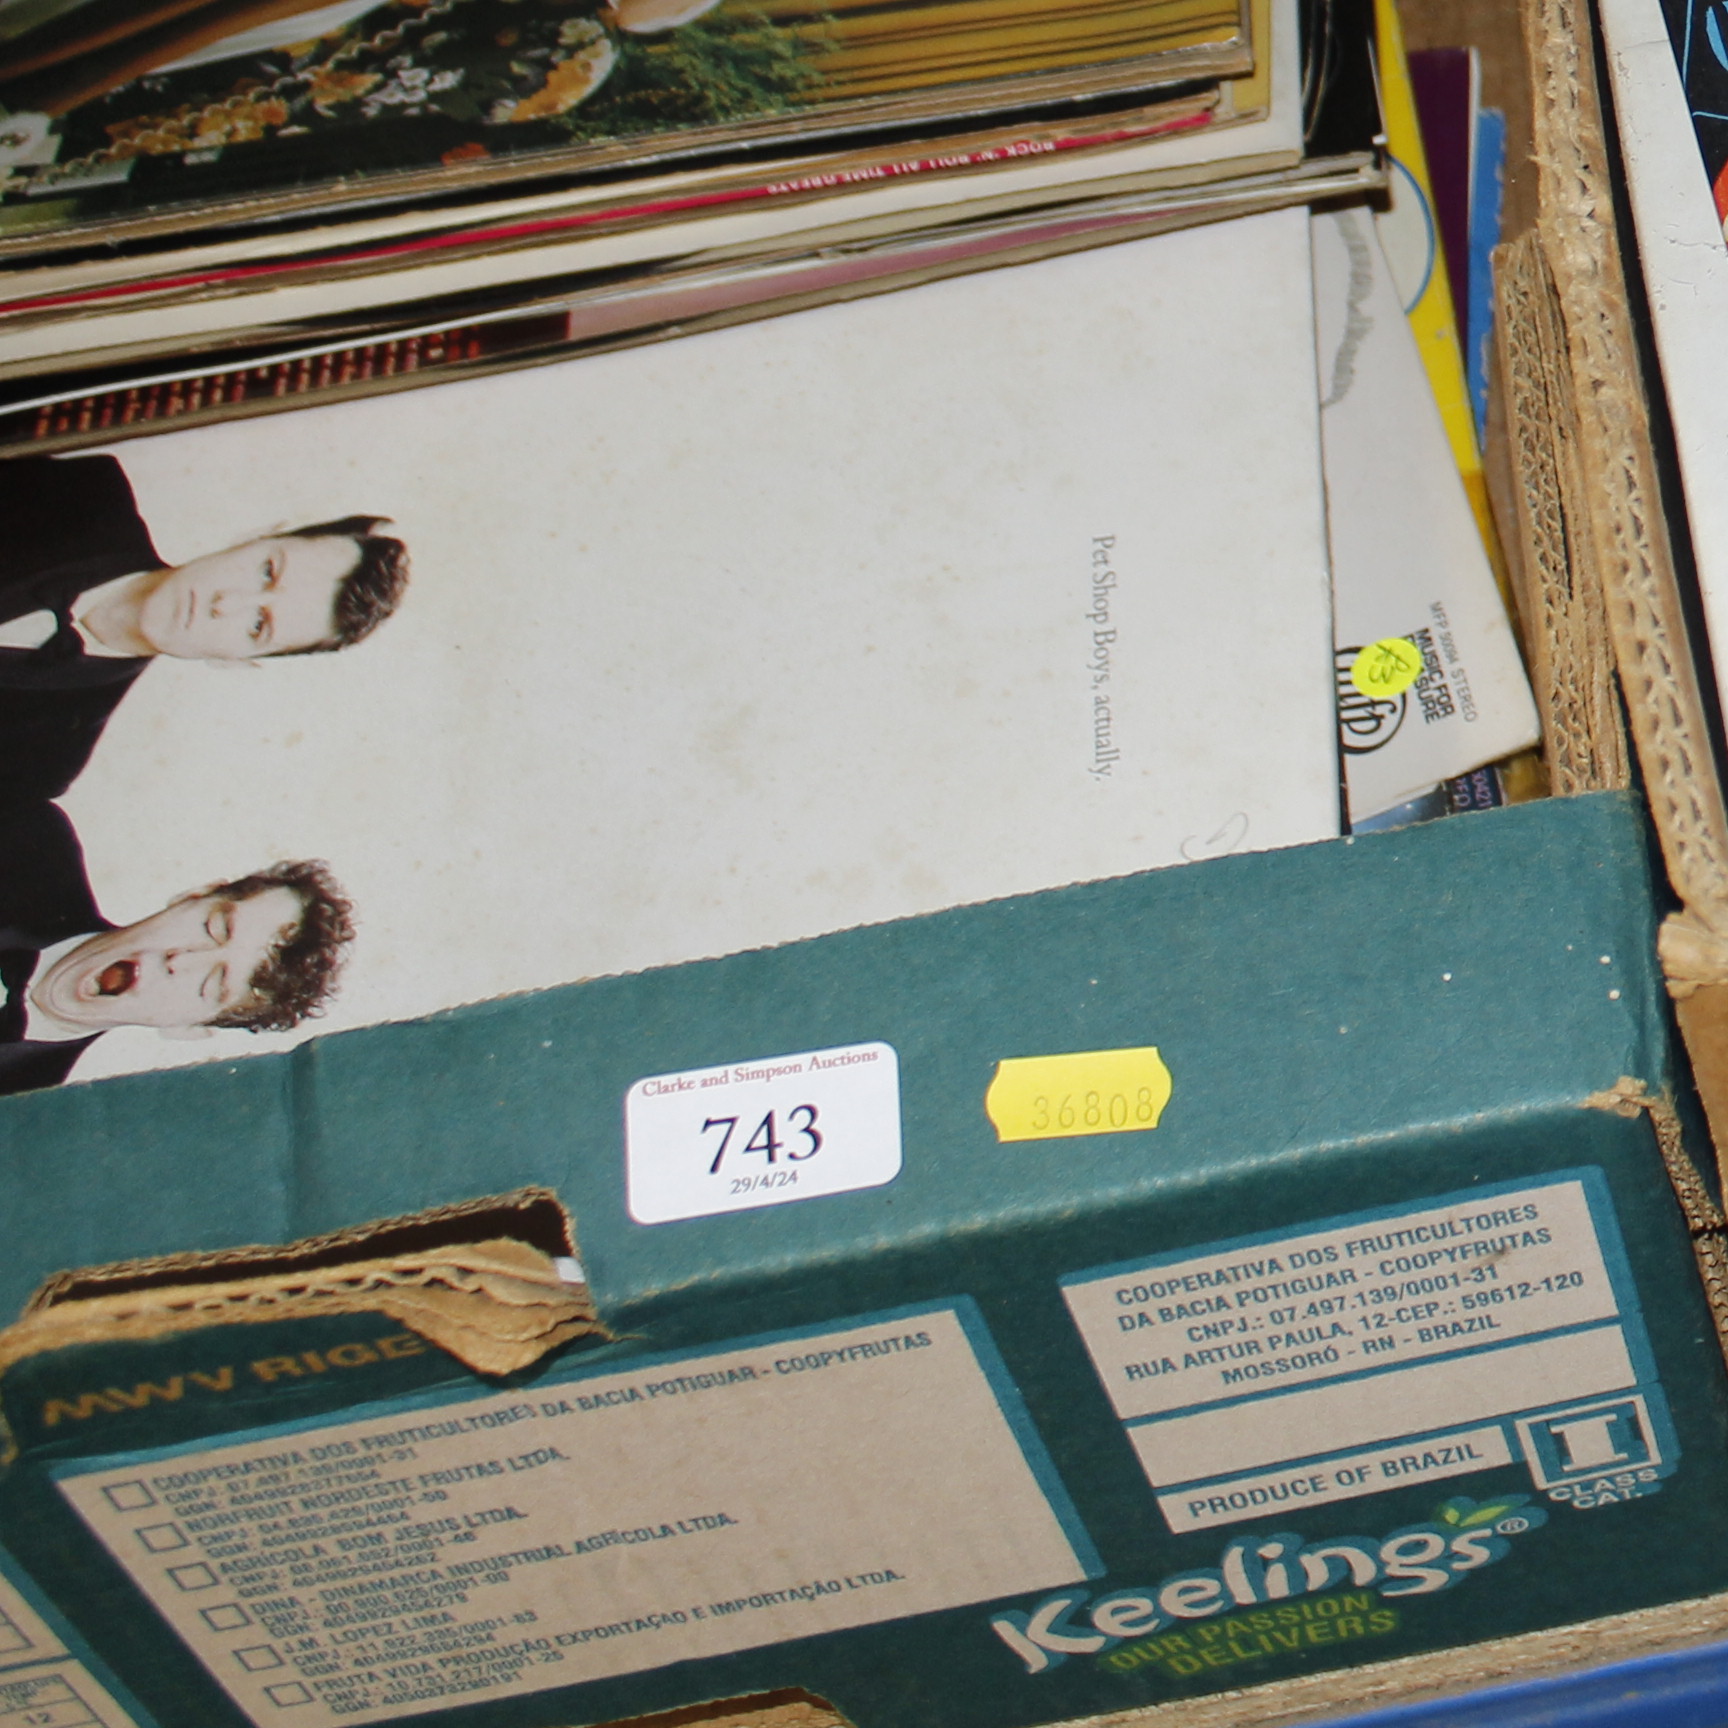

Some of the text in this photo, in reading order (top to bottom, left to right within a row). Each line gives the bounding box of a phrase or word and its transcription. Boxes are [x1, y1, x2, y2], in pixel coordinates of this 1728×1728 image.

[841, 165, 886, 183] TIME
[891, 159, 920, 174] ALL
[928, 153, 970, 169] ROLL
[1003, 138, 1056, 158] ROCK
[1081, 533, 1122, 782] Pet Shop Boys, actually.
[1415, 628, 1455, 717] MUSIC FOR
[1429, 599, 1449, 629] MFP
[1451, 667, 1478, 722] STEREO
[641, 1048, 879, 1098] Clarke and Simpson Auctions
[1031, 1084, 1156, 1133] 36808
[700, 1103, 824, 1175] 743
[729, 1169, 800, 1196] 29/4/24
[1113, 1202, 1542, 1307] COOPERATIVA DOS FRUTICULTORES
[1116, 1225, 1554, 1333] DA BACIA POTIGUAR COOPYFRUTAS
[1124, 1269, 1587, 1382] RUA ARTUR PAULA, 12-CEP.: 59612-120
[1266, 1262, 1502, 1327] 07.497.139/0001-31
[43, 1332, 427, 1427] MWV RIGE
[1217, 1312, 1502, 1385] MOSSORÓ RN BRAZIL
[147, 1449, 310, 1492] COOPERATIVA
[307, 1439, 361, 1461] DOS
[353, 1404, 542, 1451] FRUTICULTORES
[537, 1398, 576, 1418] DA
[572, 1386, 644, 1411] BACIA
[642, 1364, 761, 1398] POTIGUAR
[768, 1330, 937, 1375] COOPYFRUTAS
[1549, 1412, 1635, 1473] I
[181, 1501, 300, 1533] NORFRUIT
[295, 1477, 421, 1511] NORDESTE
[415, 1460, 507, 1488] FRUTAS
[502, 1445, 573, 1471] LTDA.
[1186, 1440, 1484, 1519] PRODUCE OF BRAZIL
[1547, 1469, 1661, 1503] CLASS
[1571, 1489, 1644, 1512] CAT.
[212, 1539, 331, 1574] AGRÍCOLA
[333, 1530, 391, 1553] BOM
[387, 1516, 464, 1541] JESUS
[458, 1503, 531, 1529] LTDA.
[247, 1594, 305, 1615] DINA
[316, 1567, 448, 1602] DINAMARCA
[441, 1542, 573, 1578] INDUSTRIAL
[563, 1519, 679, 1555] AGRÍCOLA
[673, 1511, 740, 1534] LTDA.
[278, 1610, 459, 1654] J.M. LOPEZ LIMA
[310, 1566, 909, 1693] FRUTA VIDA PRODUÇÃO EXPORTAÇÃO IMPORTAÇÃO LTDA.
[990, 1526, 1493, 1676] Keelings
[1109, 1591, 1372, 1672] OUR PASSION
[1166, 1609, 1397, 1677] DELIVERS
